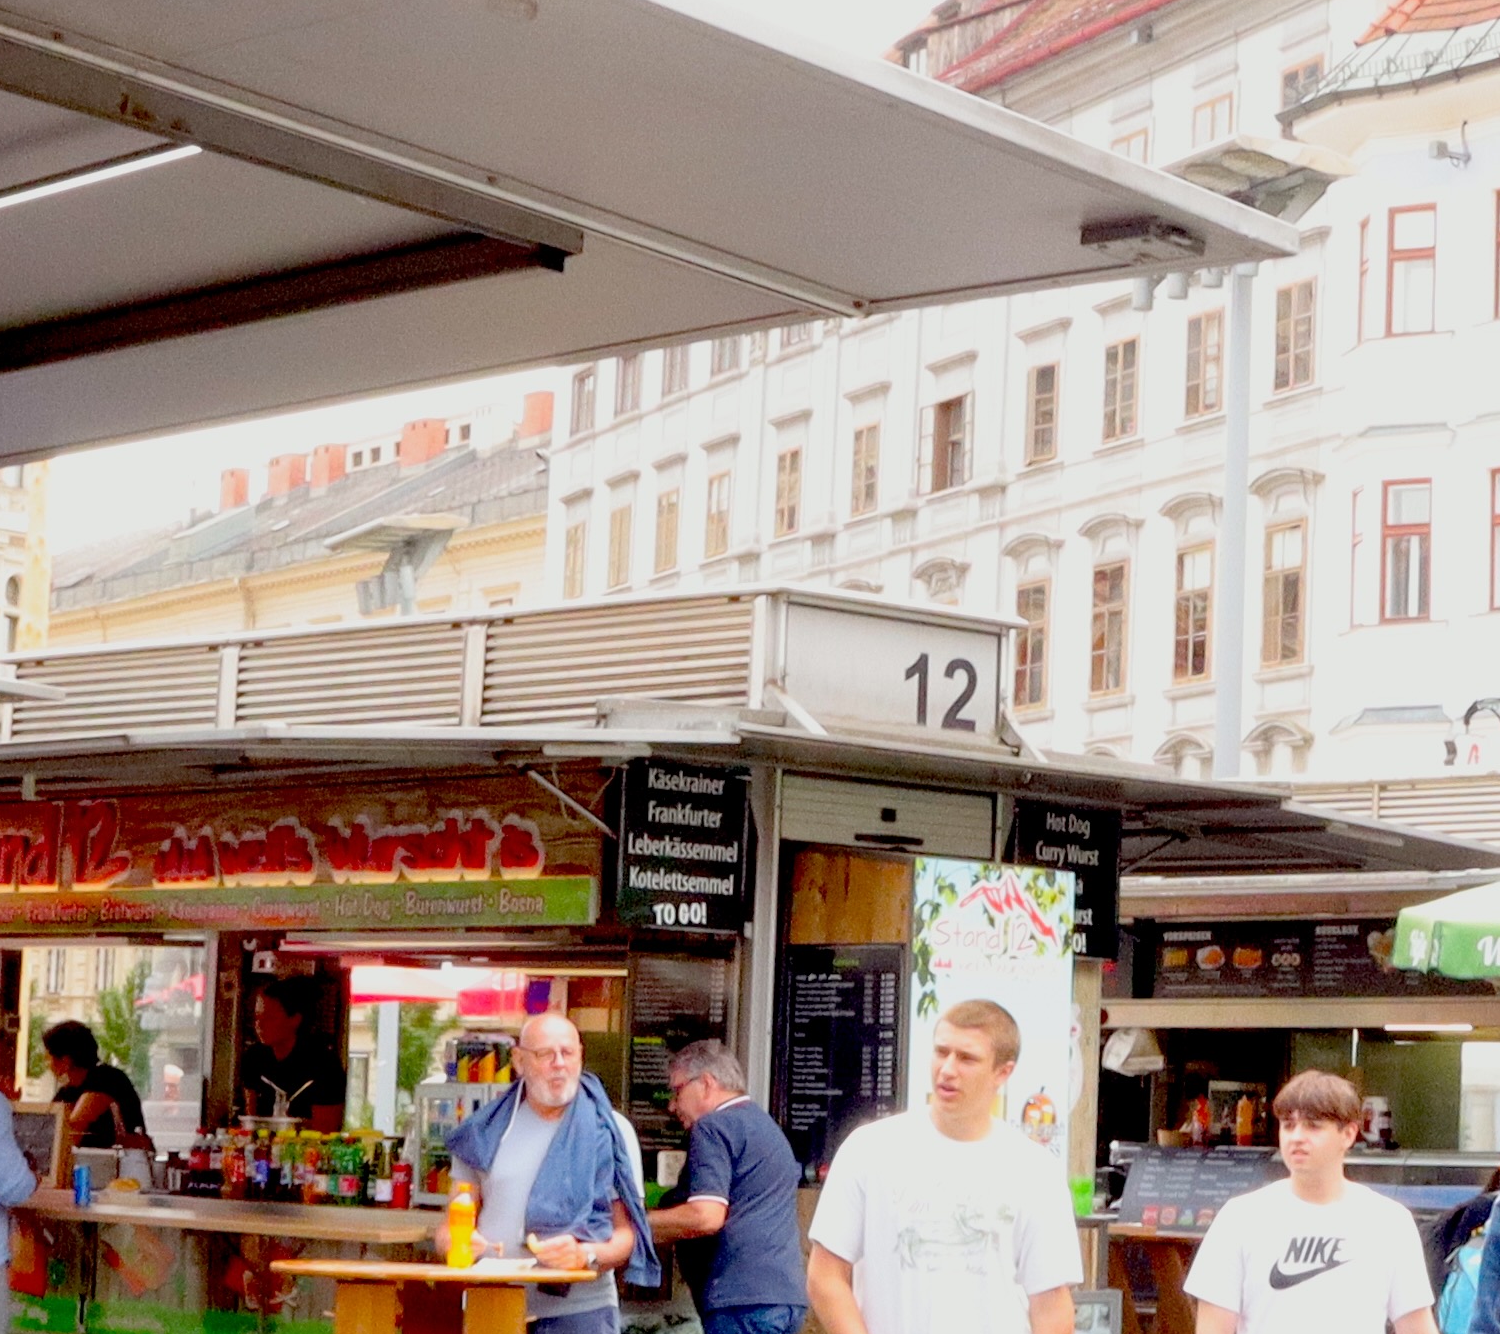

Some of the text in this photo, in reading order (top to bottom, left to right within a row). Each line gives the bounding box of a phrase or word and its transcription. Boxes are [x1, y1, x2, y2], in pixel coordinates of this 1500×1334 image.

[904, 653, 978, 732] 12
[647, 768, 726, 796] Käsekrainer
[647, 800, 723, 829] Frankfurter
[1045, 811, 1091, 839] Hot Dog
[627, 832, 739, 864] Leberkässemmel
[1035, 839, 1100, 867] Curry Wurst
[629, 866, 735, 896] Kotelettsemmel
[499, 887, 544, 915] Bosna
[652, 902, 708, 926] TO GO!
[1283, 1236, 1346, 1266] NIKE
